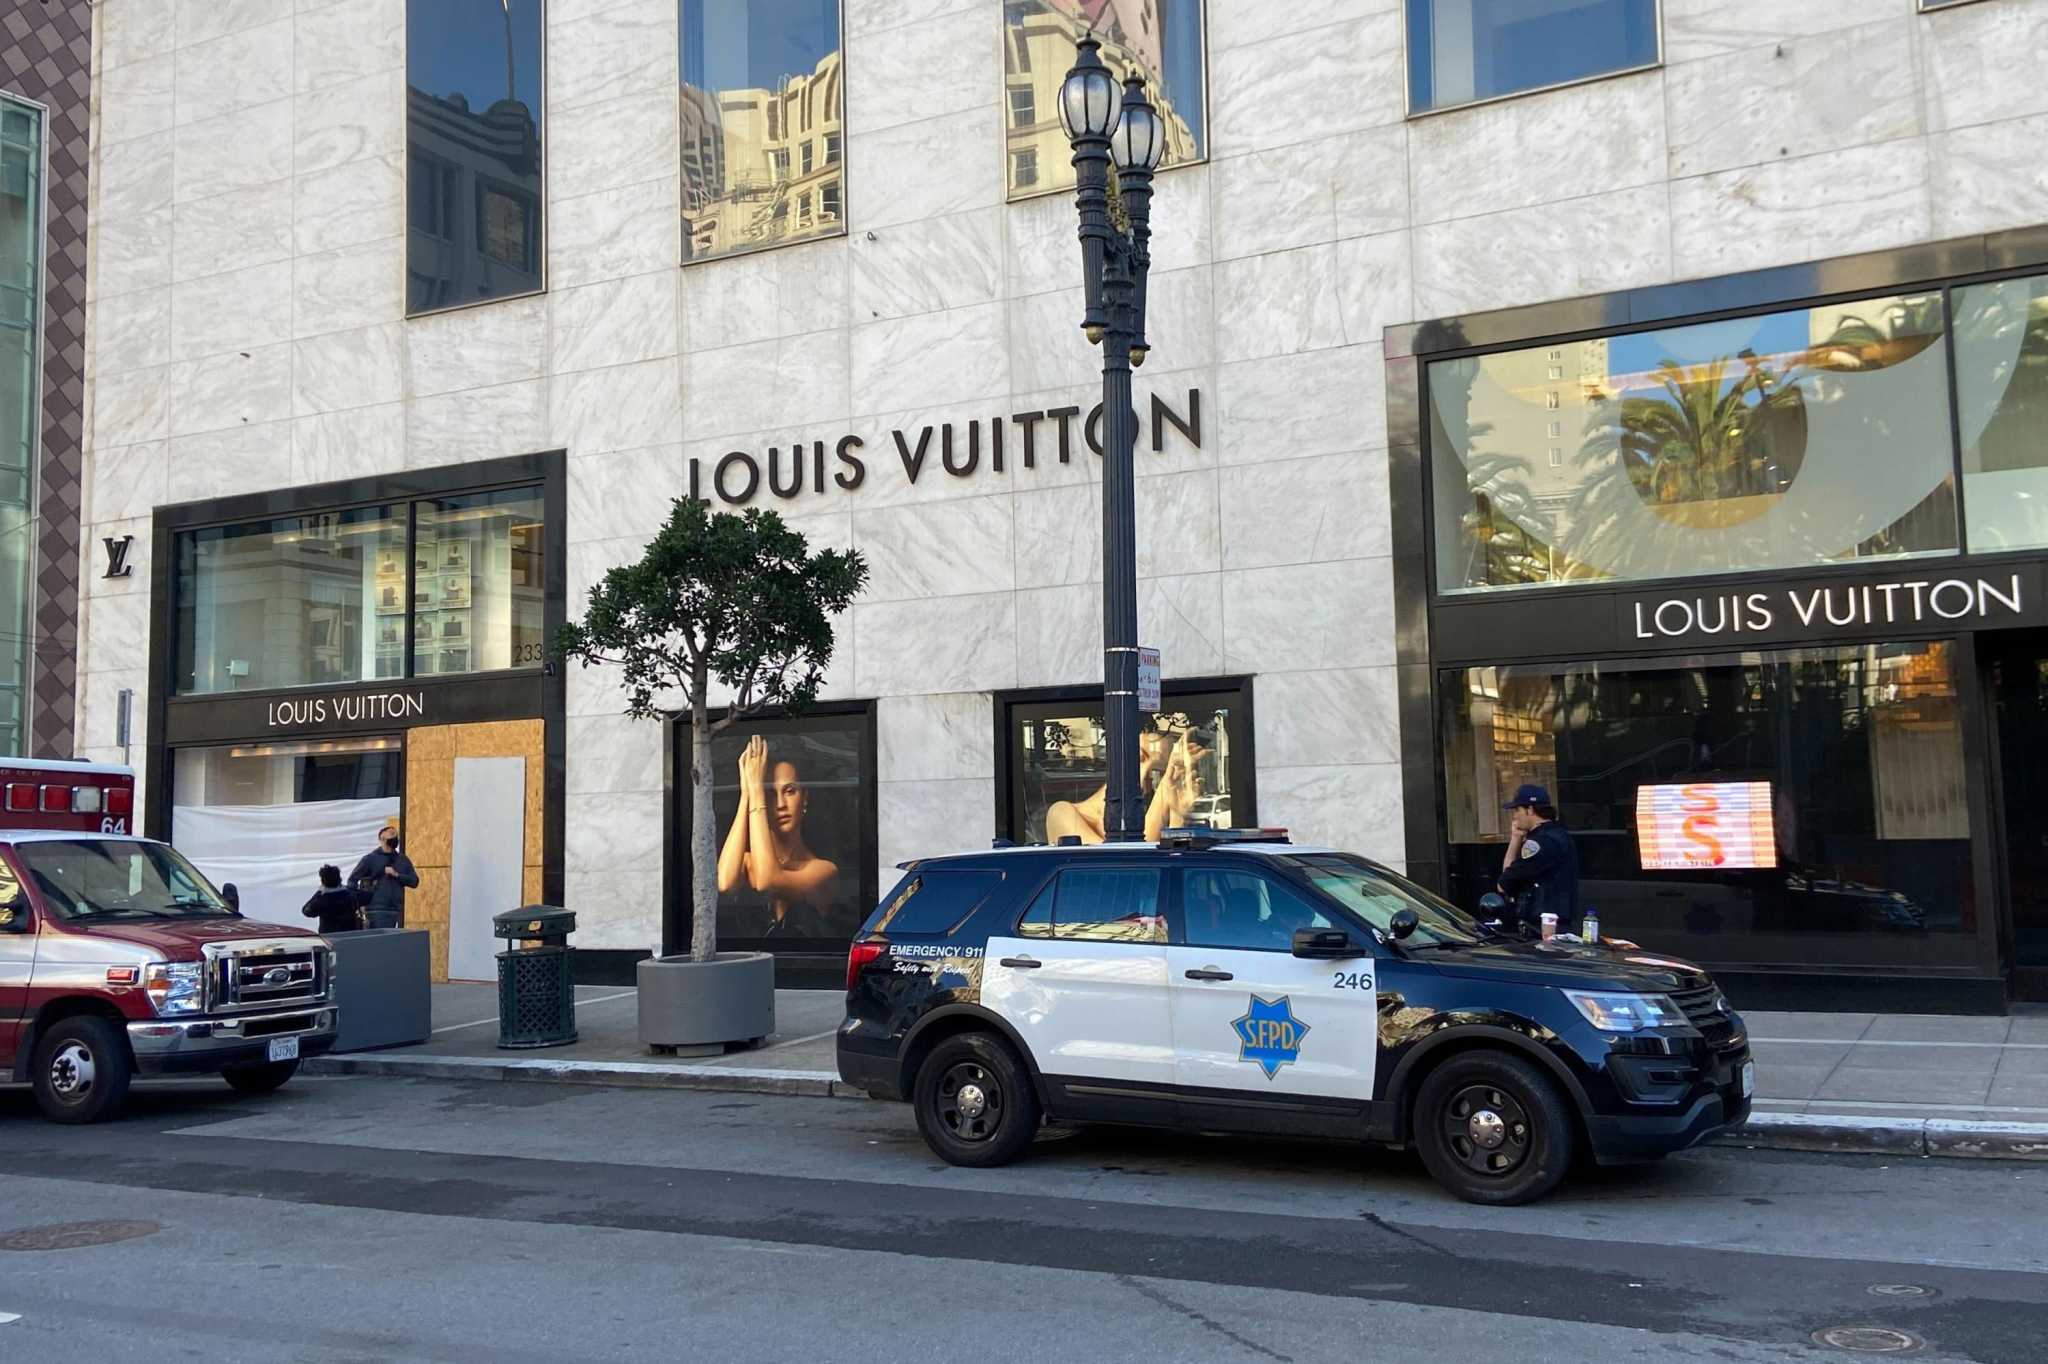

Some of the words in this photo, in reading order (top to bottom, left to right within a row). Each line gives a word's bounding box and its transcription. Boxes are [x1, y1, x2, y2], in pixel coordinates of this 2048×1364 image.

[689, 434, 866, 508] LOUIS
[1634, 592, 1774, 639] LOUIS
[1788, 574, 2022, 627] VUITTON
[514, 643, 543, 662] 233
[268, 699, 326, 726] LOUIS
[333, 692, 423, 721] VUITTON
[101, 817, 126, 834] 64
[889, 945, 961, 957] EMERGENCY
[965, 946, 984, 958] 911
[893, 961, 919, 976] Safety
[1333, 972, 1373, 990] 246
